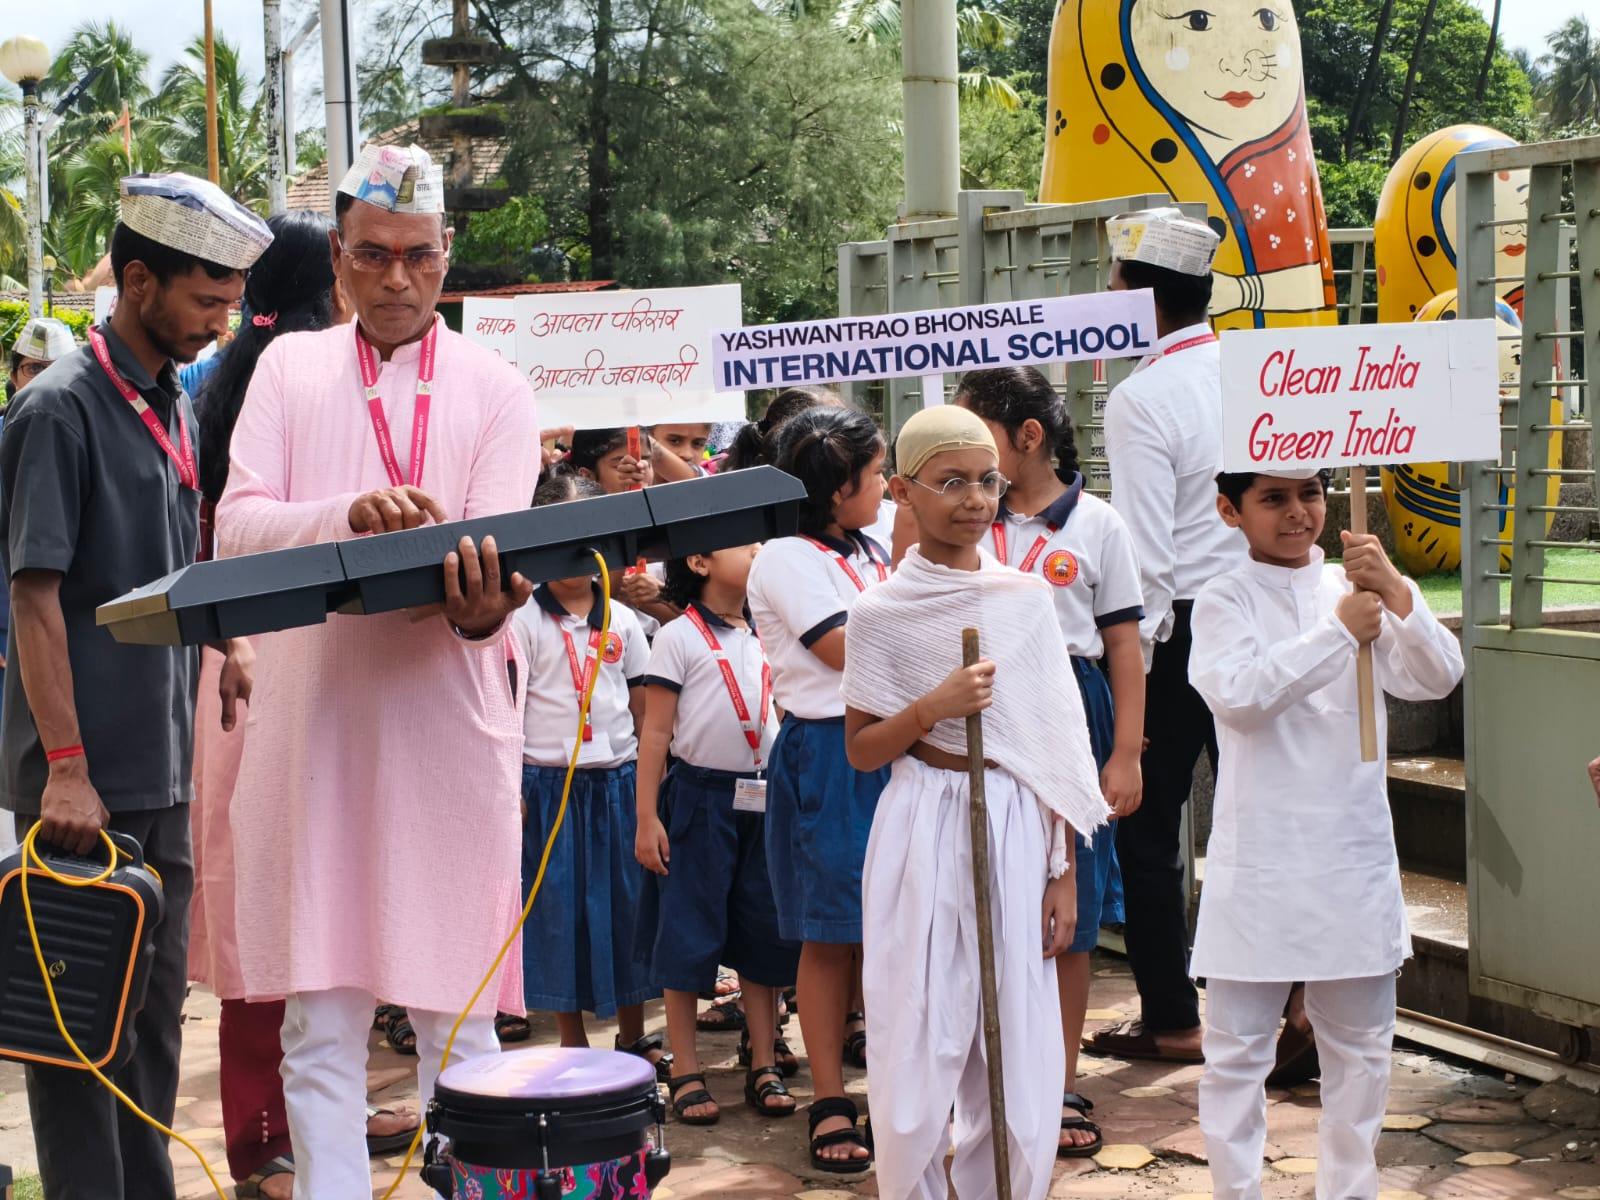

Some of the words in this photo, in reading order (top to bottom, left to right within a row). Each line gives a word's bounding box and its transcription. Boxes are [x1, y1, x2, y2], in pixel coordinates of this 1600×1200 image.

[530, 312, 608, 338] आपला
[611, 297, 684, 333] परिसर
[721, 318, 908, 351] YASHWANTRAO
[915, 305, 1044, 335] BHONSALE
[530, 349, 605, 391] आपली
[602, 344, 699, 400] जबाबदारी
[723, 339, 999, 387] INTERNATIONAL
[1007, 323, 1149, 360] SCHOOL
[1259, 349, 1341, 398] Clean
[1349, 345, 1421, 392] India
[1248, 412, 1334, 462] Green
[1341, 408, 1416, 457] India
